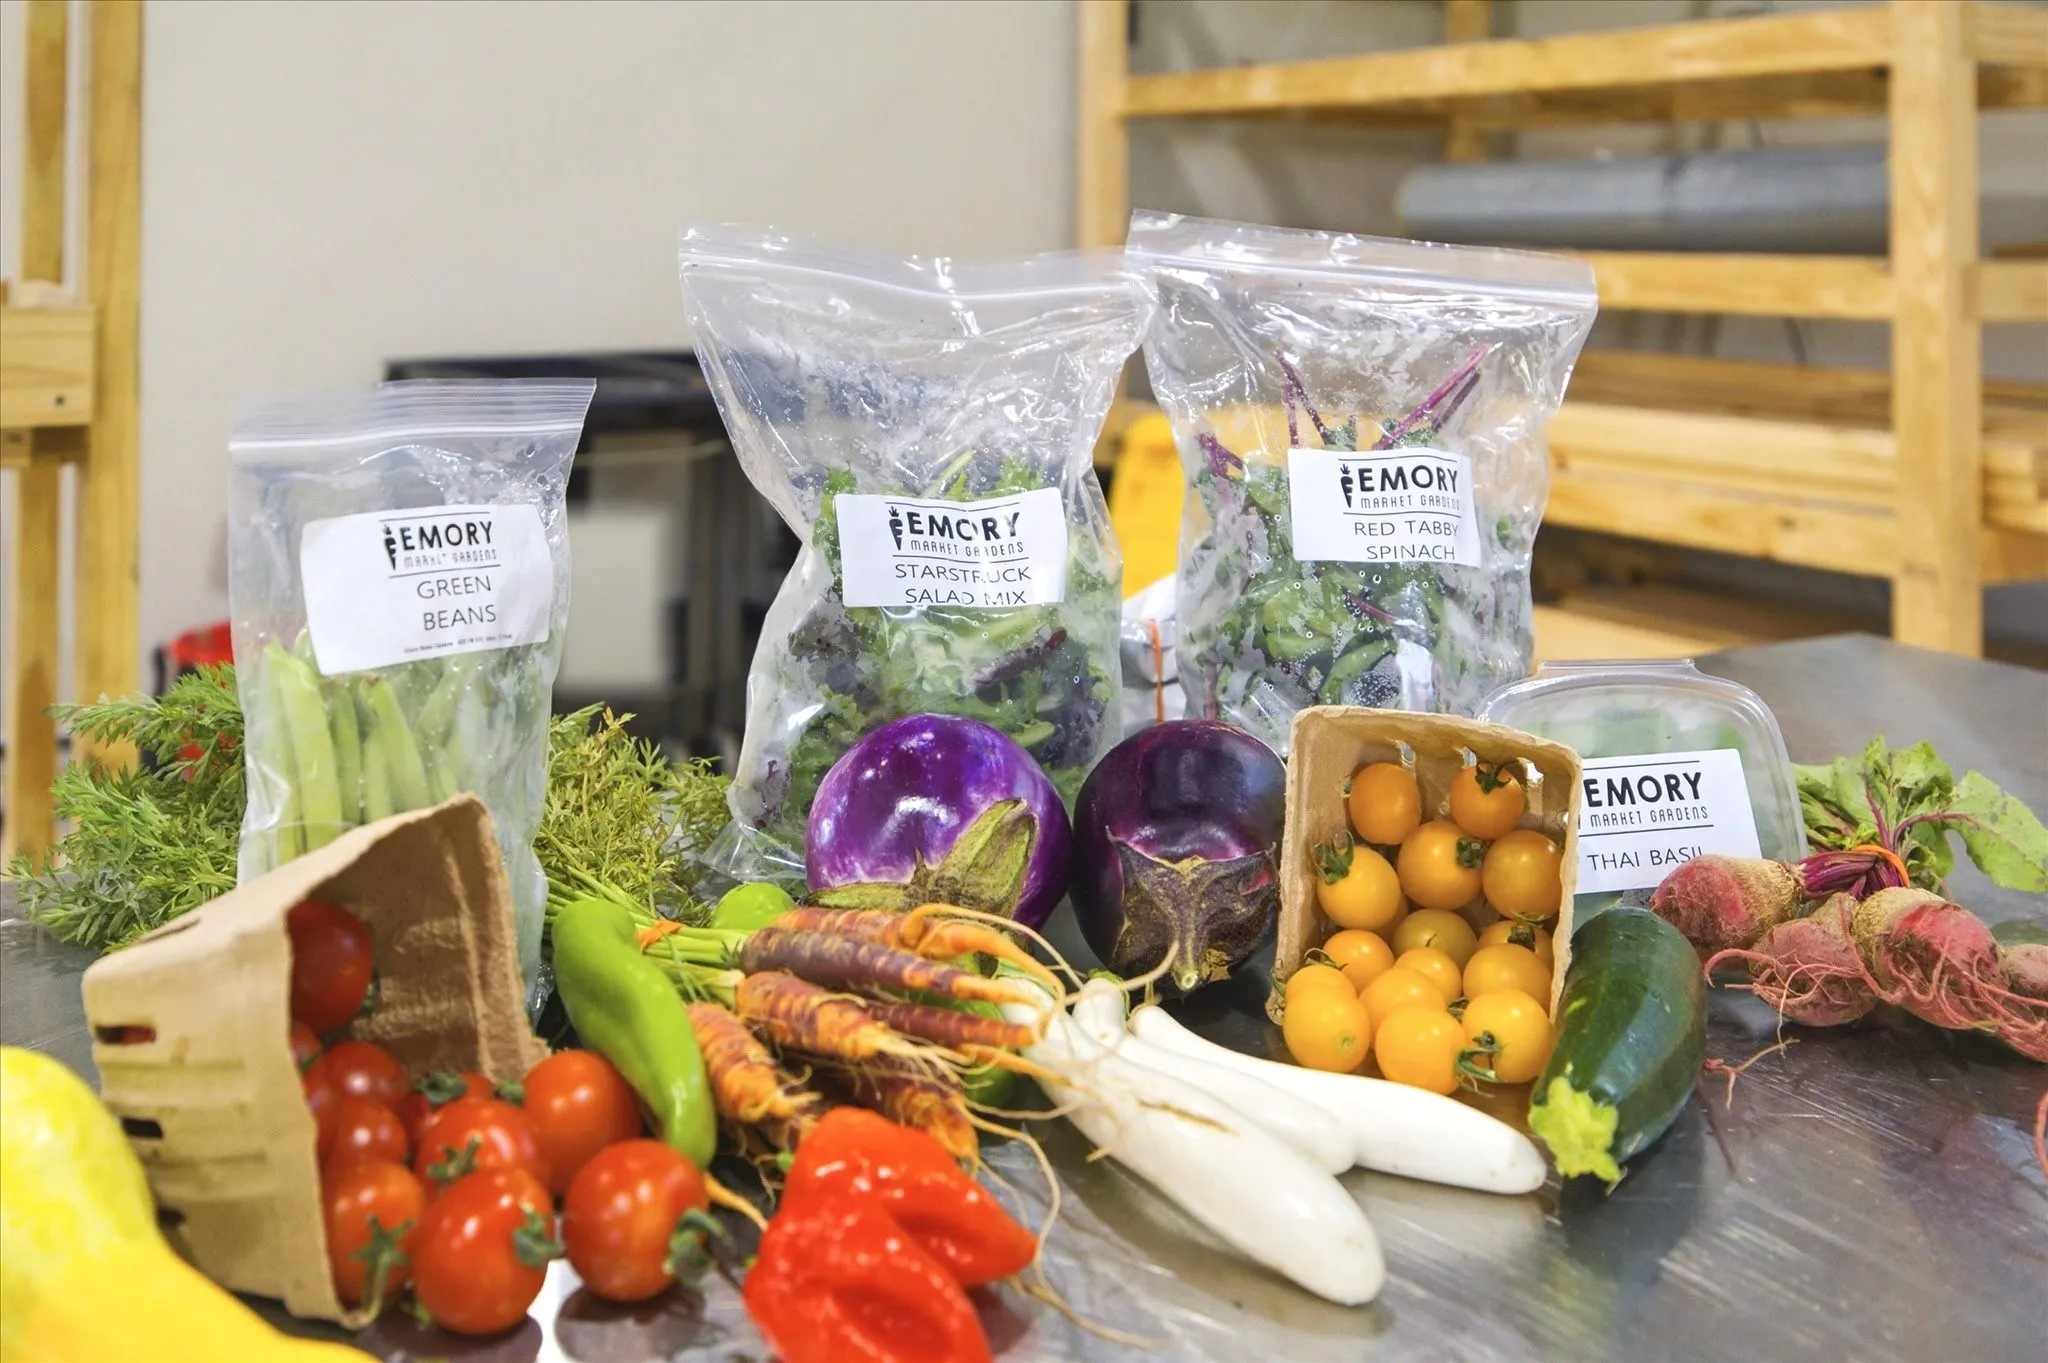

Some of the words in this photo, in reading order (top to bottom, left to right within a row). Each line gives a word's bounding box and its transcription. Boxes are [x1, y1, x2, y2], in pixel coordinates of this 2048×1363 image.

[1358, 464, 1458, 493] EMORY
[1360, 494, 1412, 509] MARKET
[1420, 494, 1460, 510] GARDENS
[399, 521, 492, 551] EMORY
[906, 511, 1020, 541] EMORY
[1354, 522, 1395, 537] RED
[1404, 520, 1458, 537] TABBY
[911, 539, 958, 555] MARKET
[1366, 544, 1455, 561] SPINACH
[417, 575, 491, 600] GREEN
[905, 588, 975, 605] SALAD
[424, 604, 496, 631] BEANS
[1583, 772, 1701, 808] EMORY
[1590, 811, 1642, 828] MARKET
[1650, 806, 1708, 822] GARDENS
[1587, 851, 1641, 871] THAI
